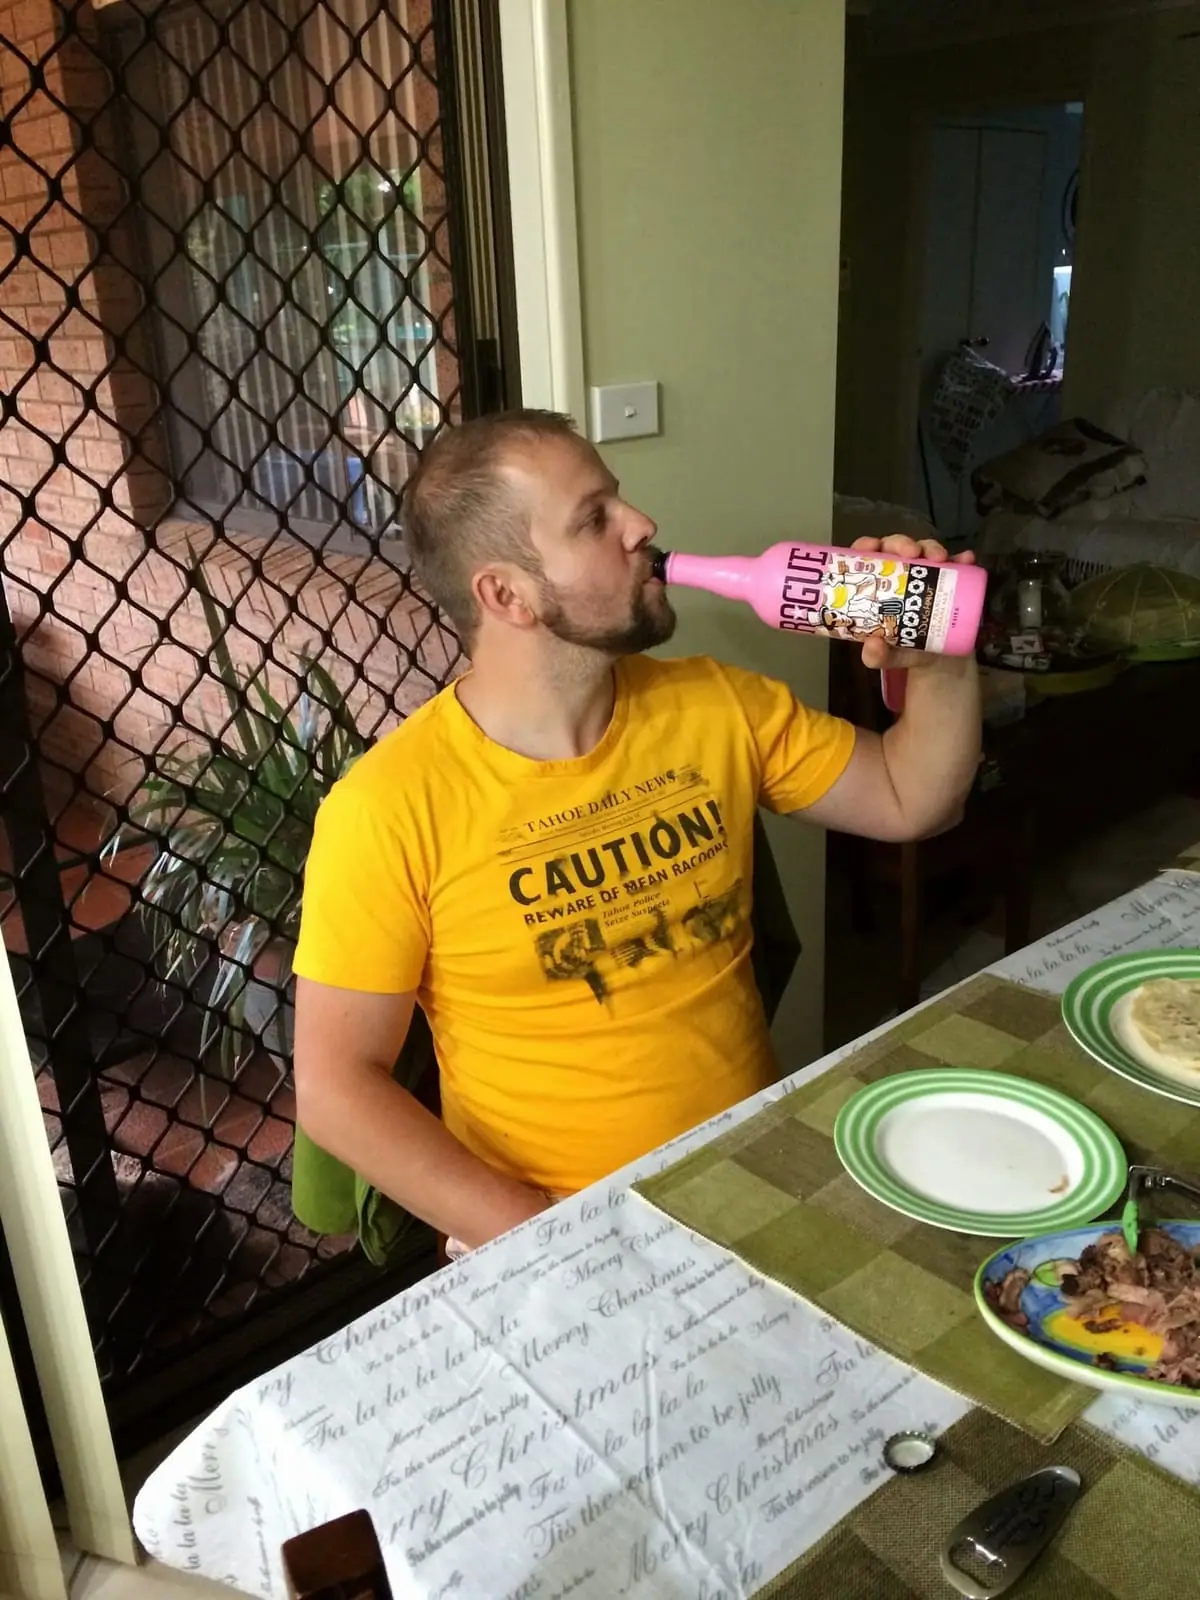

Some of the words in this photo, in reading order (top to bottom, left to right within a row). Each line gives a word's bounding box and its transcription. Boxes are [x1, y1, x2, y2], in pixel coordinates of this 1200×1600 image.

[779, 548, 828, 634] ROGUE
[900, 566, 928, 647] VOODOO
[523, 804, 584, 833] TAHOE
[588, 788, 632, 815] DAILY
[634, 770, 677, 798] NEWS
[509, 799, 724, 906] CAUTION!
[523, 895, 597, 926] BEWARE
[599, 886, 620, 903] OF
[624, 870, 669, 895] MEAN
[580, 1200, 603, 1221] la
[607, 1188, 627, 1208] la
[565, 1252, 624, 1290] Merry
[587, 1257, 696, 1318] Christmas
[302, 1270, 471, 1365] Christmas
[356, 1400, 377, 1426] la
[386, 1383, 409, 1407] la
[416, 1365, 438, 1389] la
[445, 1343, 466, 1370] la
[500, 1315, 521, 1337] la
[575, 1452, 597, 1479] la
[603, 1428, 628, 1457] la
[632, 1408, 654, 1438] la
[659, 1390, 682, 1417] la
[686, 1372, 708, 1400] la
[580, 1491, 615, 1525] the
[689, 1423, 710, 1445] to
[712, 1402, 735, 1428] be
[737, 1372, 783, 1426] jolly
[705, 1414, 839, 1516] Christmas
[1153, 1424, 1179, 1443] la
